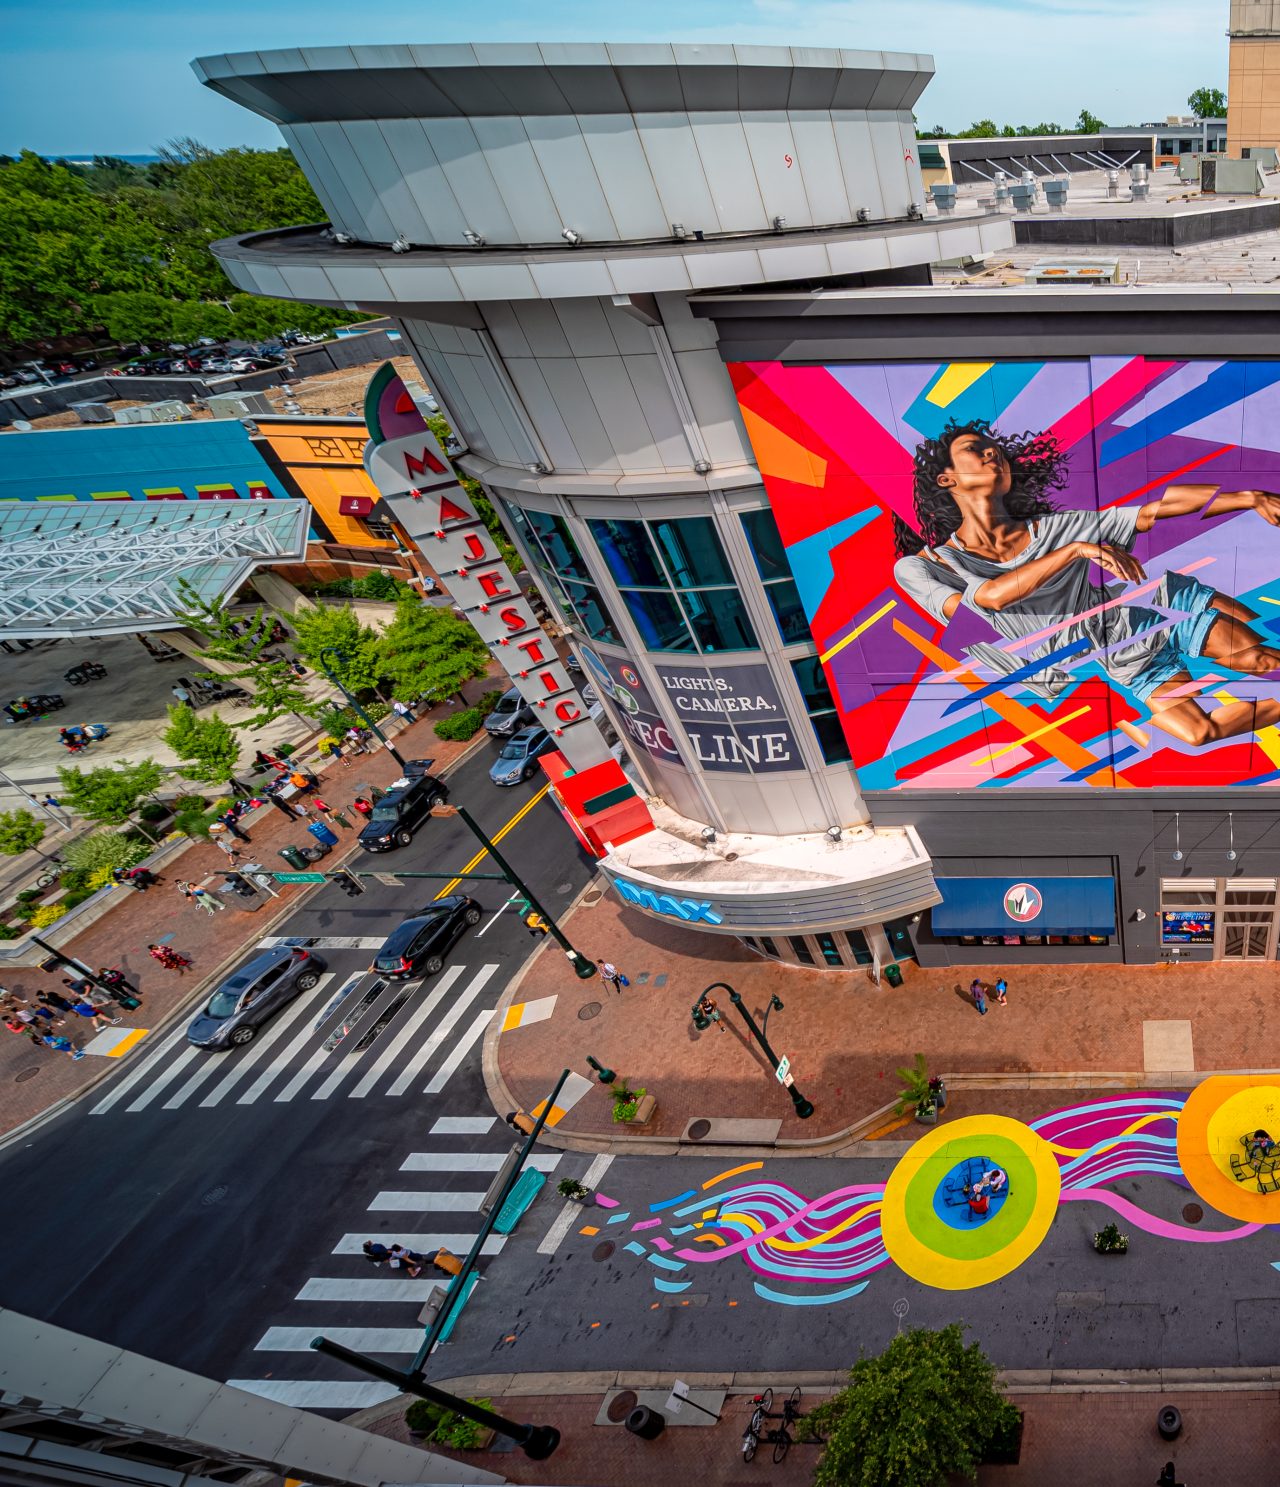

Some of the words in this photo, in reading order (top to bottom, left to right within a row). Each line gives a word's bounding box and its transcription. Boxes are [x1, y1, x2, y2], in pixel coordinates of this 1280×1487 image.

[404, 447, 581, 723] MAJESTIC
[662, 676, 733, 693] LIGHTS,
[676, 695, 777, 713] CAMERA,
[613, 878, 722, 925] IMAX
